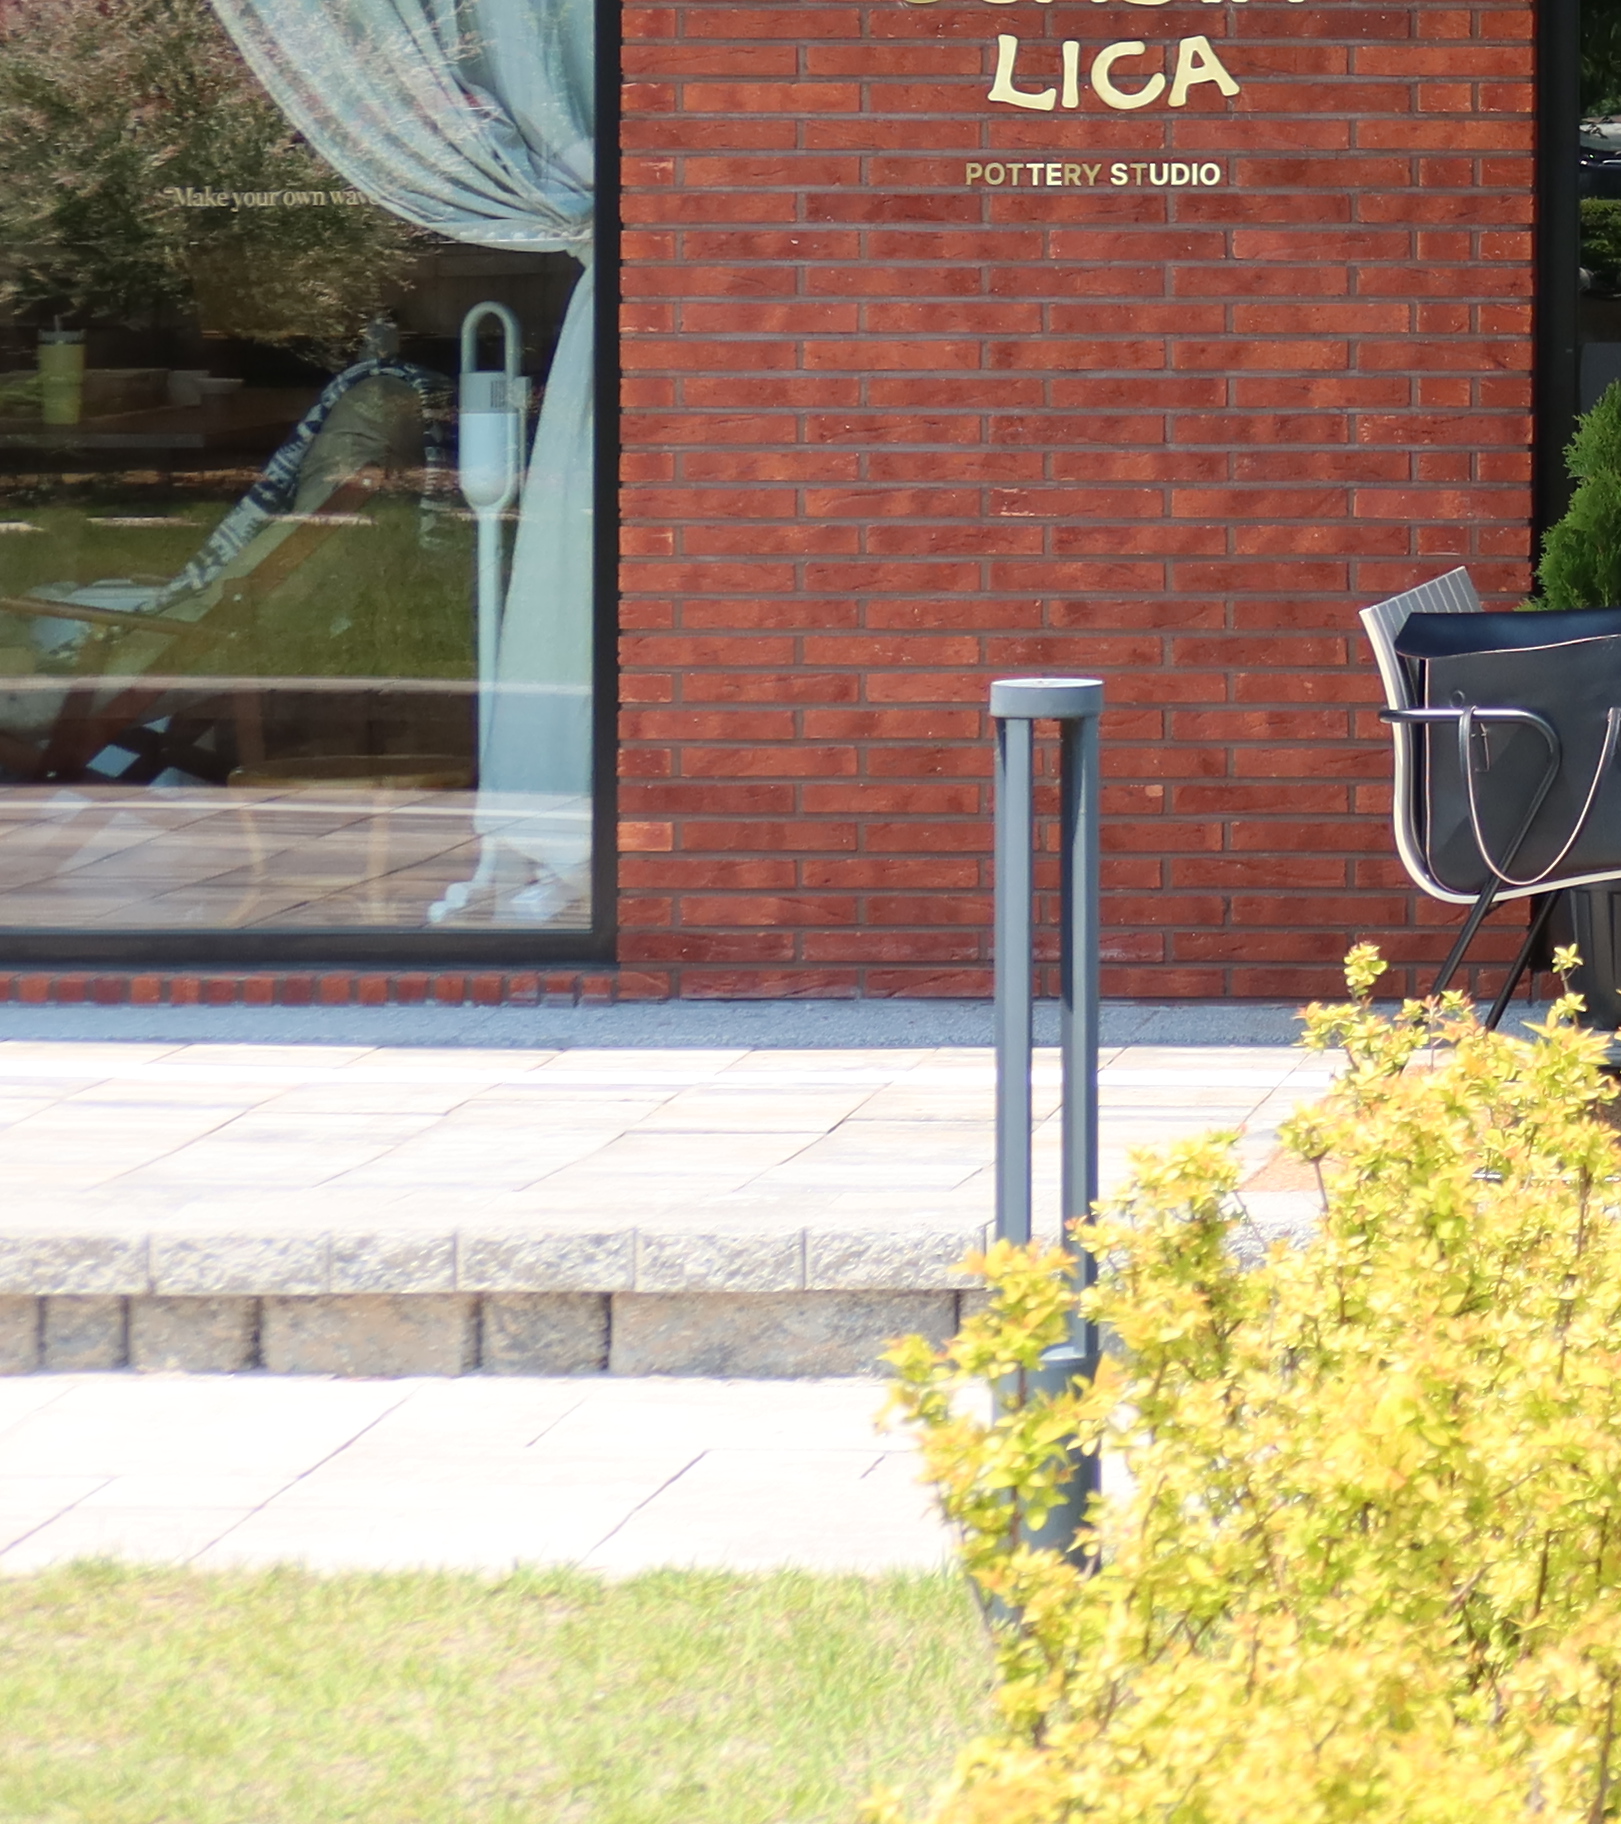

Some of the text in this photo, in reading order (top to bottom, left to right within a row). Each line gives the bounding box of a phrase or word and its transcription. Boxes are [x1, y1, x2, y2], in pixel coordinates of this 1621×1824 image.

[987, 34, 1241, 111] LICA
[965, 162, 1222, 187] POTTERY STUDIO
[231, 189, 277, 213] your
[282, 190, 326, 207] own
